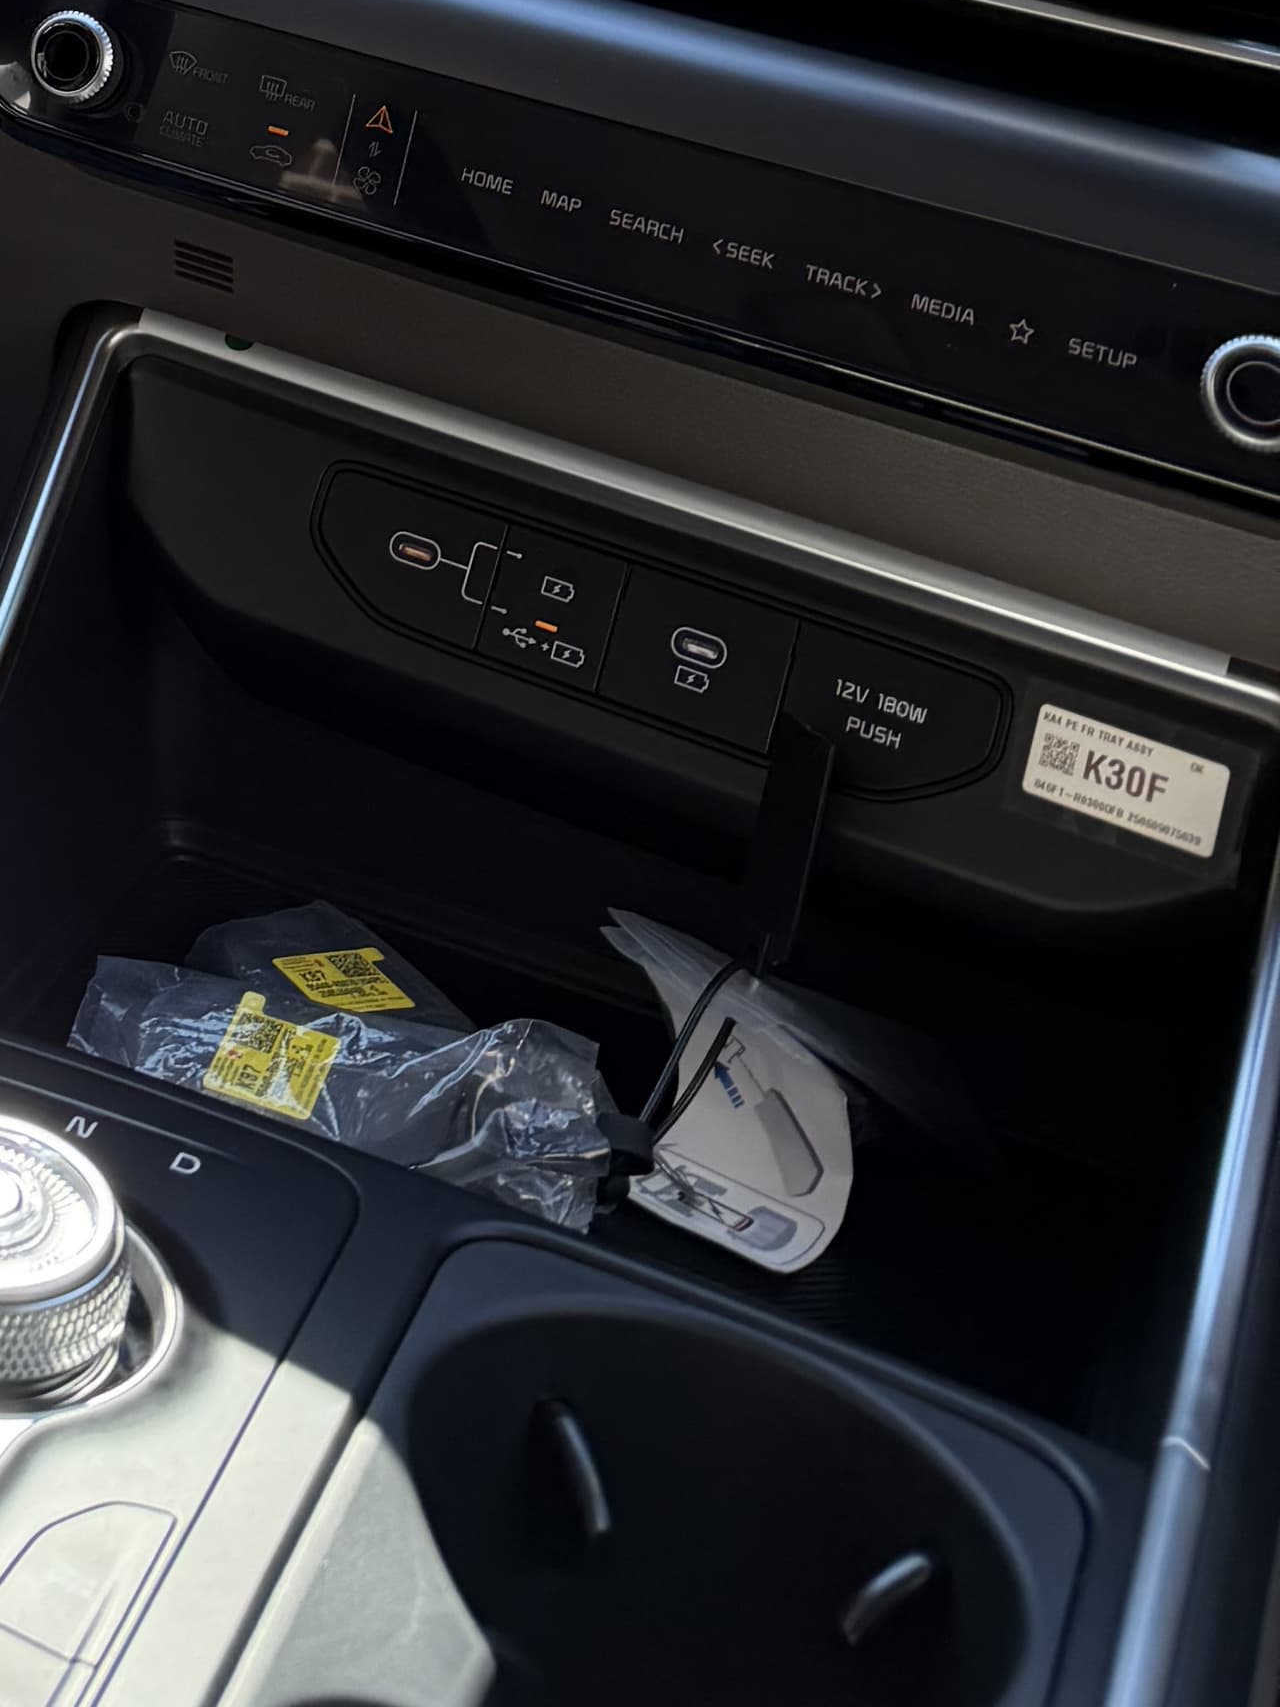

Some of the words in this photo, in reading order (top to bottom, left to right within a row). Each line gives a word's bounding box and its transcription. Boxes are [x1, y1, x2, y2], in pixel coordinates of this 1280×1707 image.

[193, 65, 230, 84] FRONT
[284, 91, 315, 111] REAR
[162, 110, 208, 136] AUTO
[461, 167, 513, 195] HOME
[541, 189, 582, 213] MAP
[609, 209, 685, 244] SEARCH
[911, 293, 975, 326] MEDIA
[1068, 337, 1137, 369] SETUP
[836, 679, 870, 703] 12V
[877, 693, 928, 724] 180W
[845, 715, 901, 749] PUSH
[1083, 750, 1169, 803] K30F
[65, 1115, 98, 1138] N
[169, 1152, 201, 1174] D
